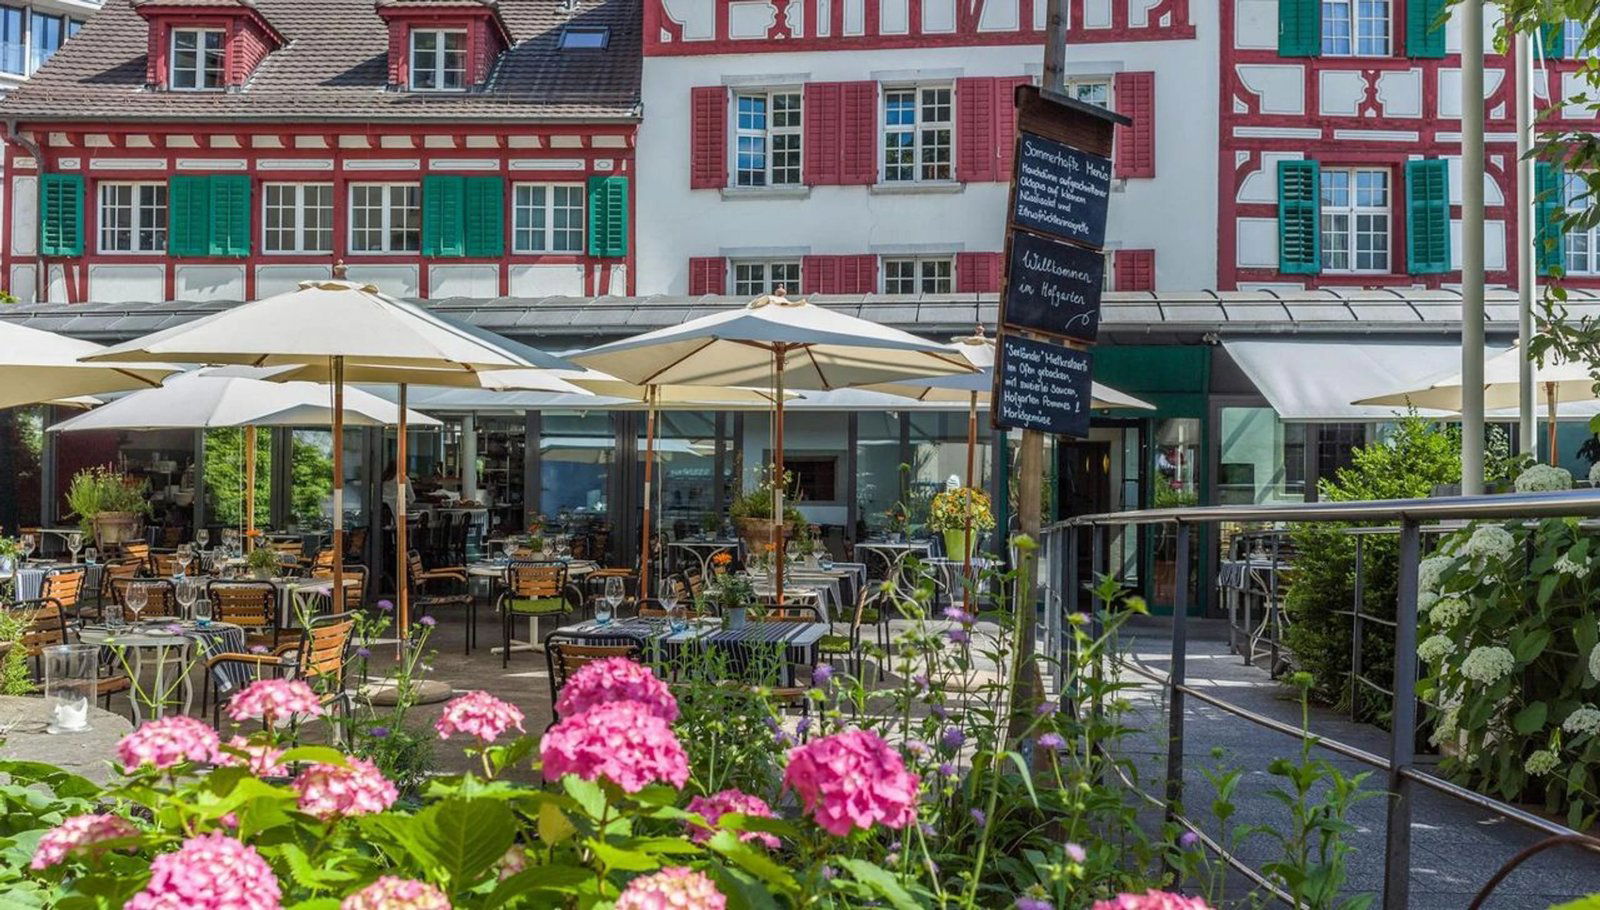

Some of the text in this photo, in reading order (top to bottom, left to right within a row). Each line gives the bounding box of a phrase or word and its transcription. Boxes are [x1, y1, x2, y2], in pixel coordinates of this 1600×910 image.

[1024, 140, 1080, 173] Sommerhafte
[1020, 176, 1046, 195] Oktopus
[1047, 186, 1060, 198] auf
[1057, 203, 1072, 213] und
[1022, 250, 1092, 284] Willkommen
[1041, 281, 1086, 307] Hofgarten
[1018, 363, 1036, 378] Ofen
[1003, 390, 1040, 409] Hofgarten
[1042, 395, 1072, 411] Pommes
